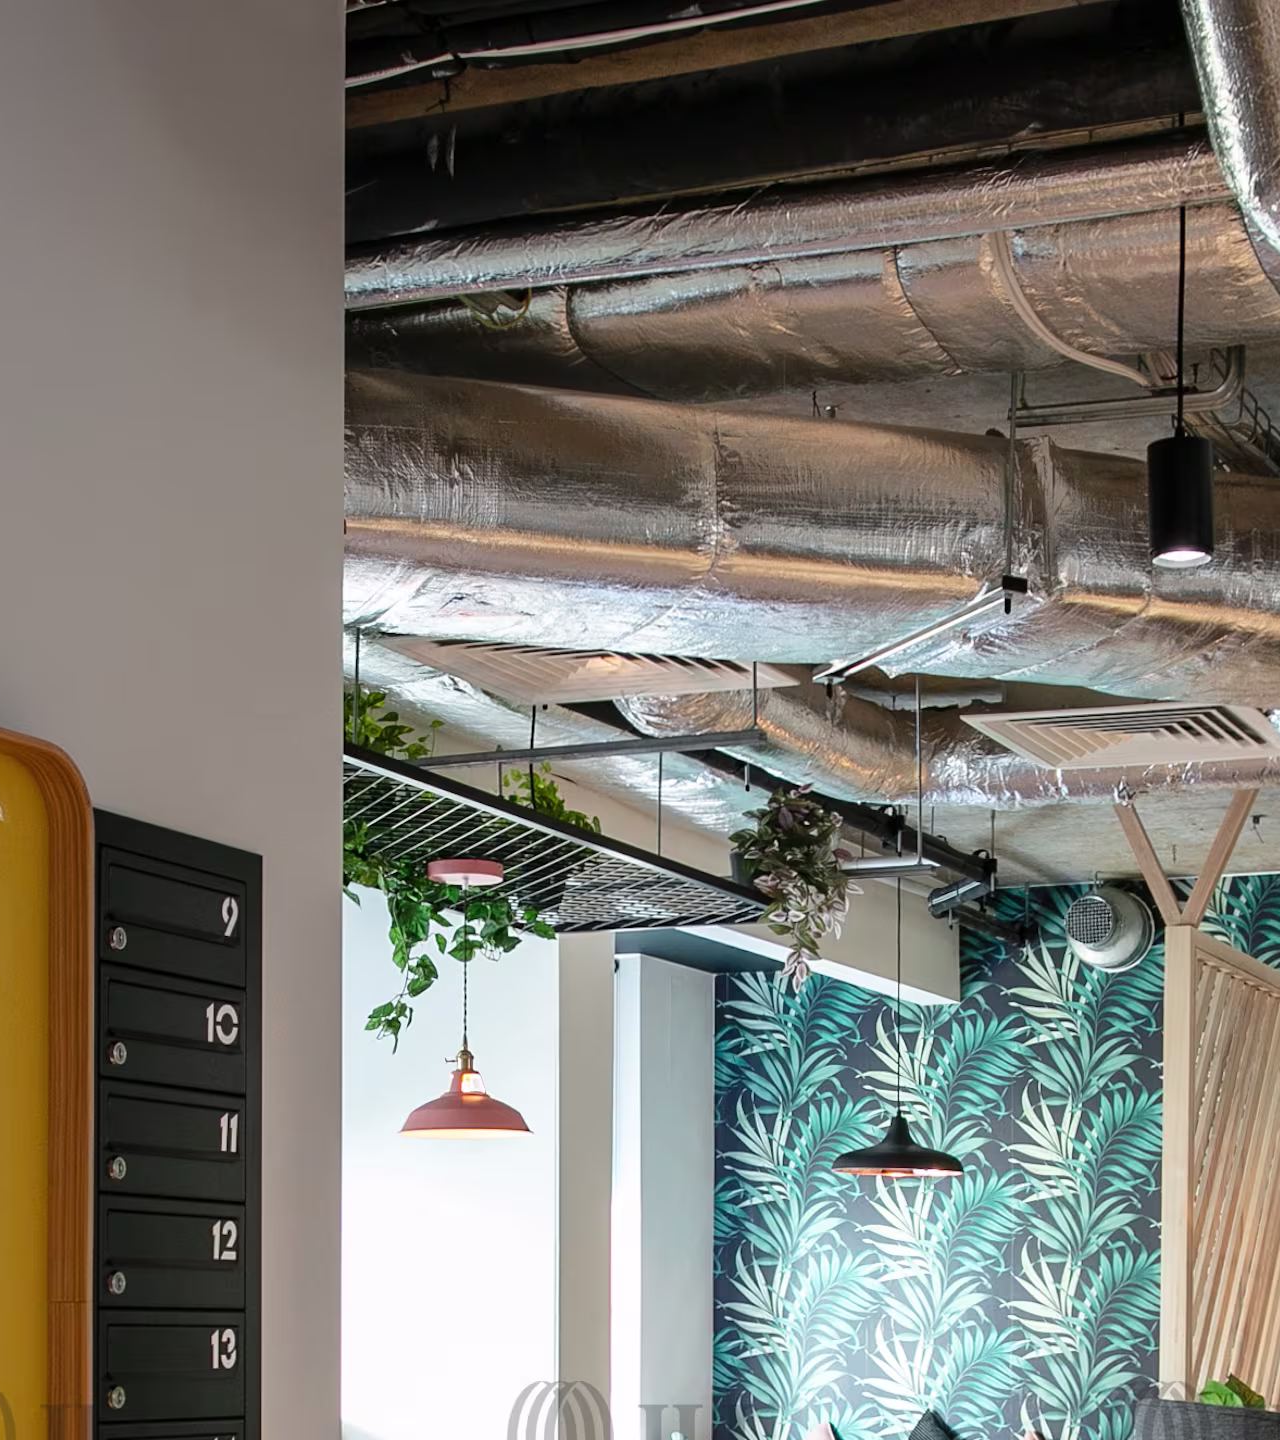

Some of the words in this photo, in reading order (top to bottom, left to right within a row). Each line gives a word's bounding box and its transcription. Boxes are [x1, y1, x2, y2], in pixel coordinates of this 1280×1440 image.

[221, 896, 239, 937] 9
[206, 1003, 239, 1045] 10
[220, 1113, 239, 1153] 11
[212, 1220, 238, 1261] 12
[210, 1328, 238, 1370] 13
